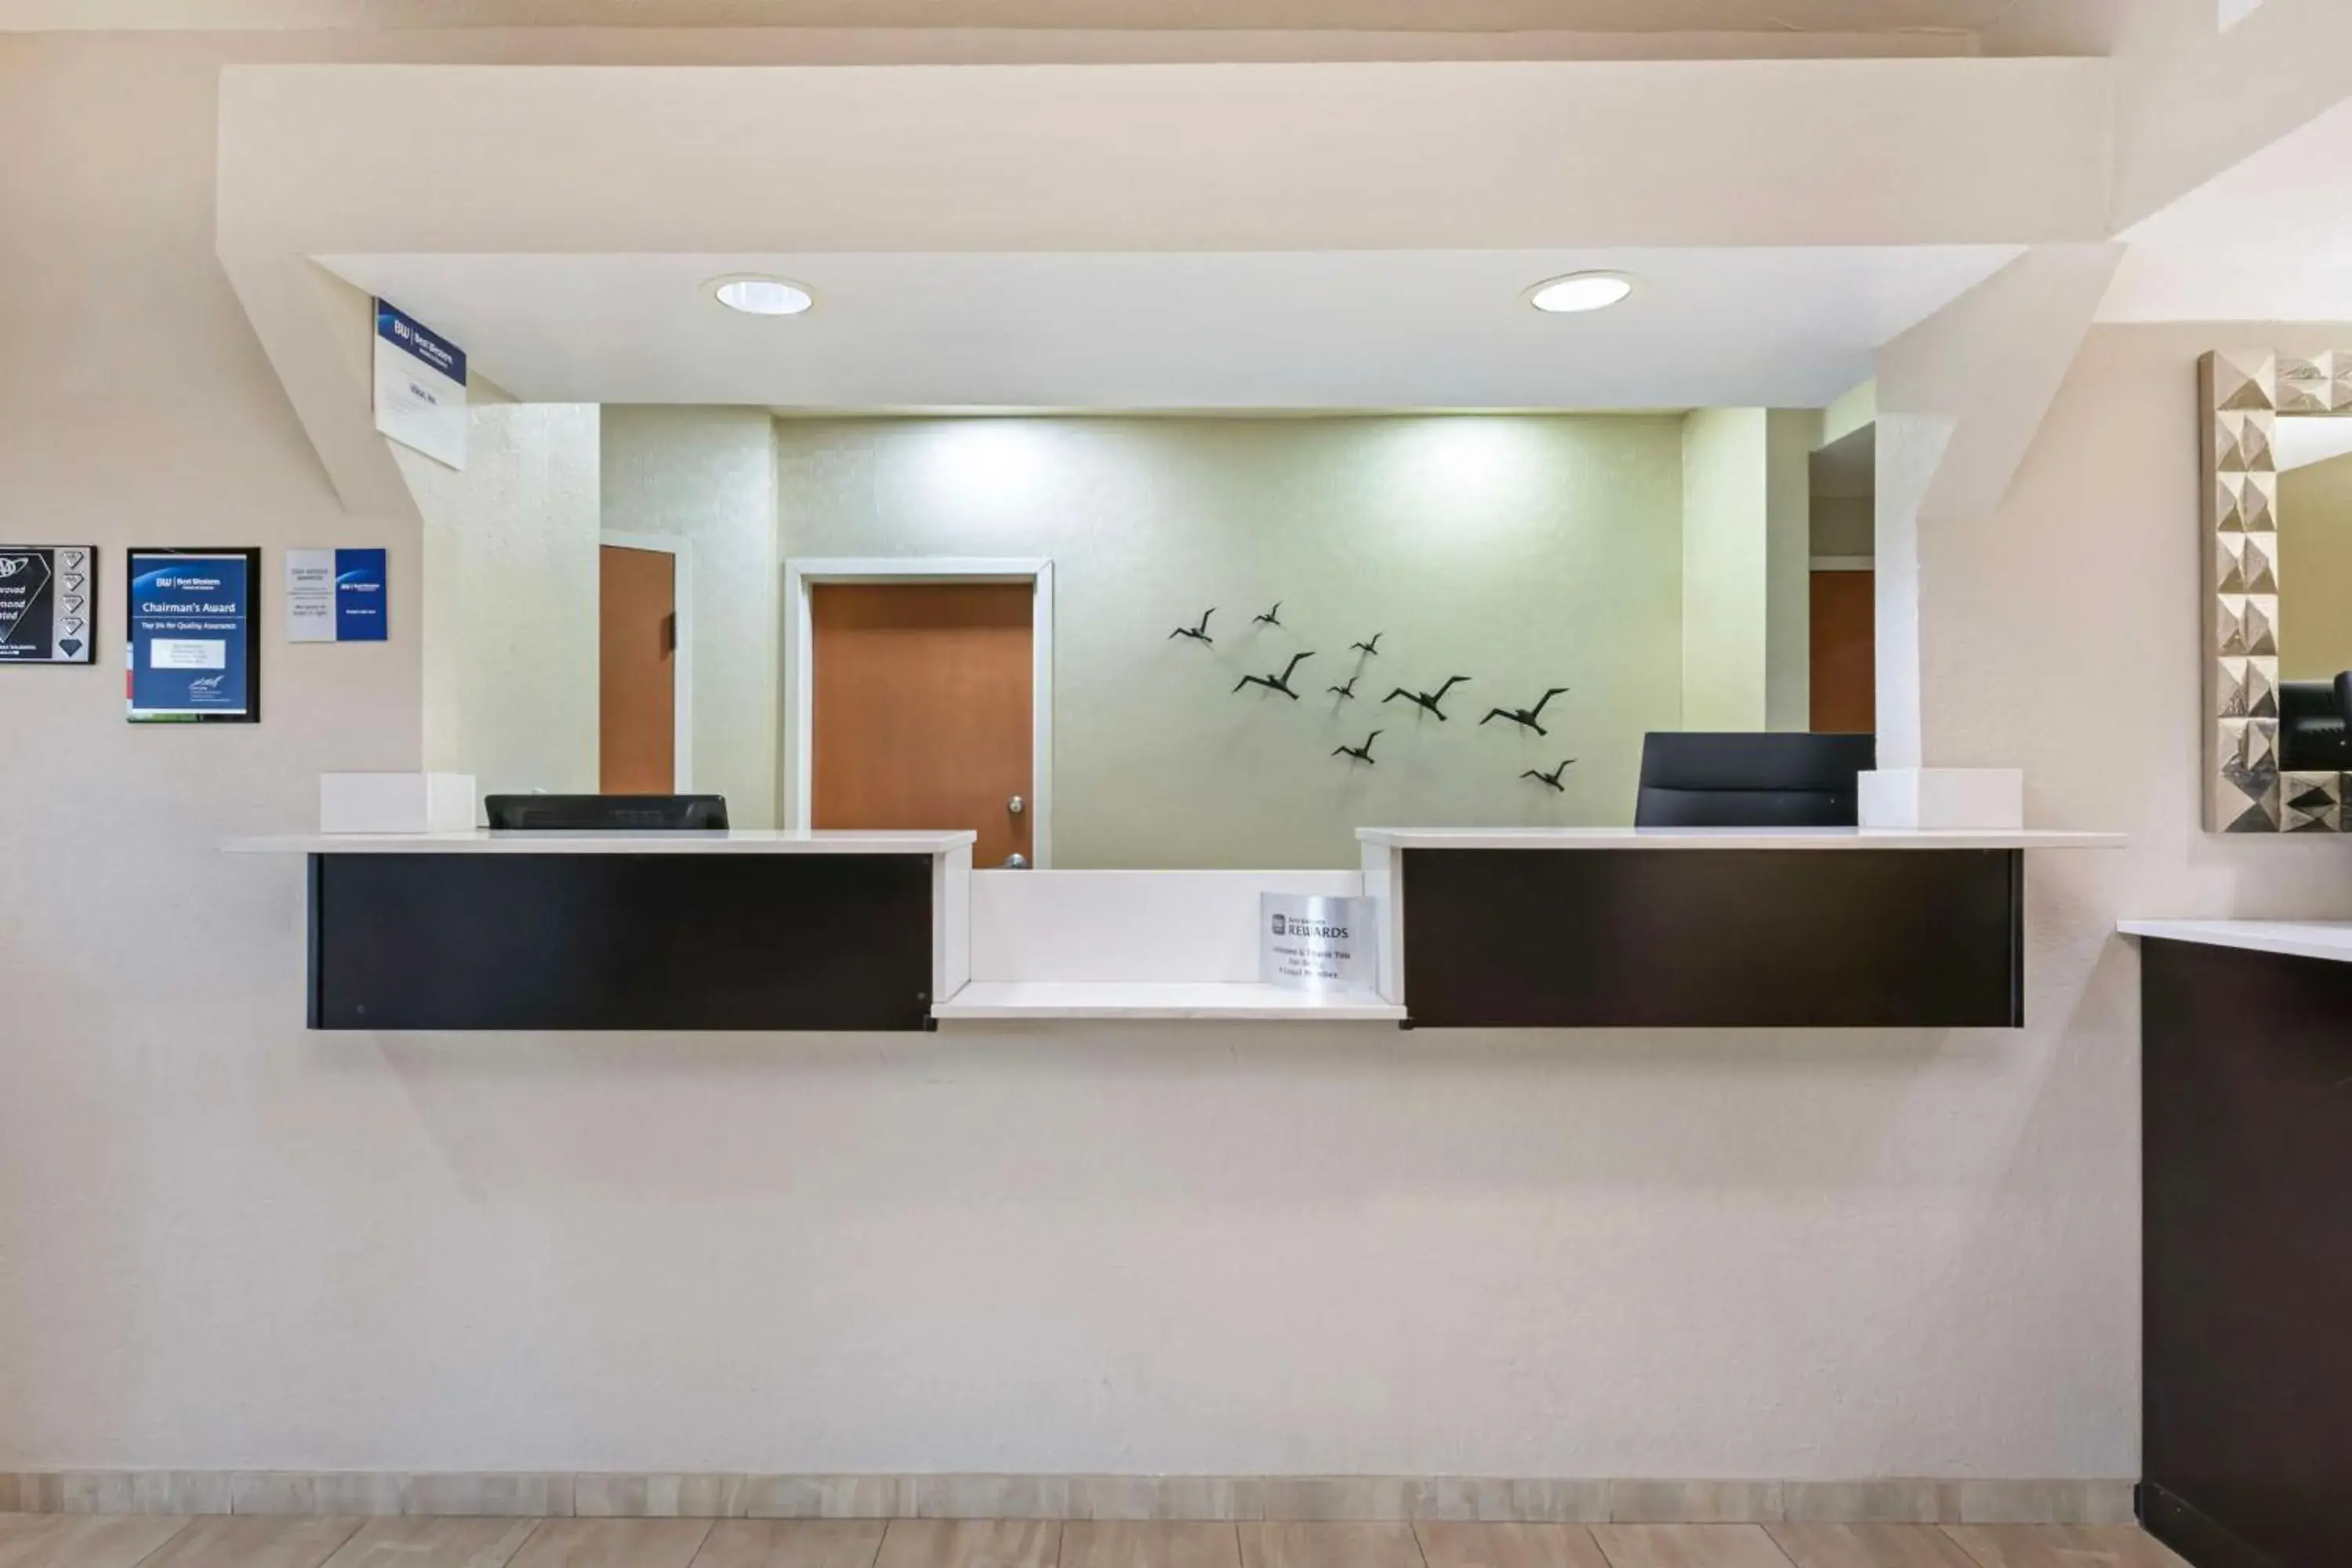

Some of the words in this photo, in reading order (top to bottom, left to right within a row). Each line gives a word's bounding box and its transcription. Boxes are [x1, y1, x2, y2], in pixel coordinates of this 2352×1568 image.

[394, 320, 410, 339] BW
[142, 602, 201, 612] Chairman's
[202, 603, 236, 612] Award
